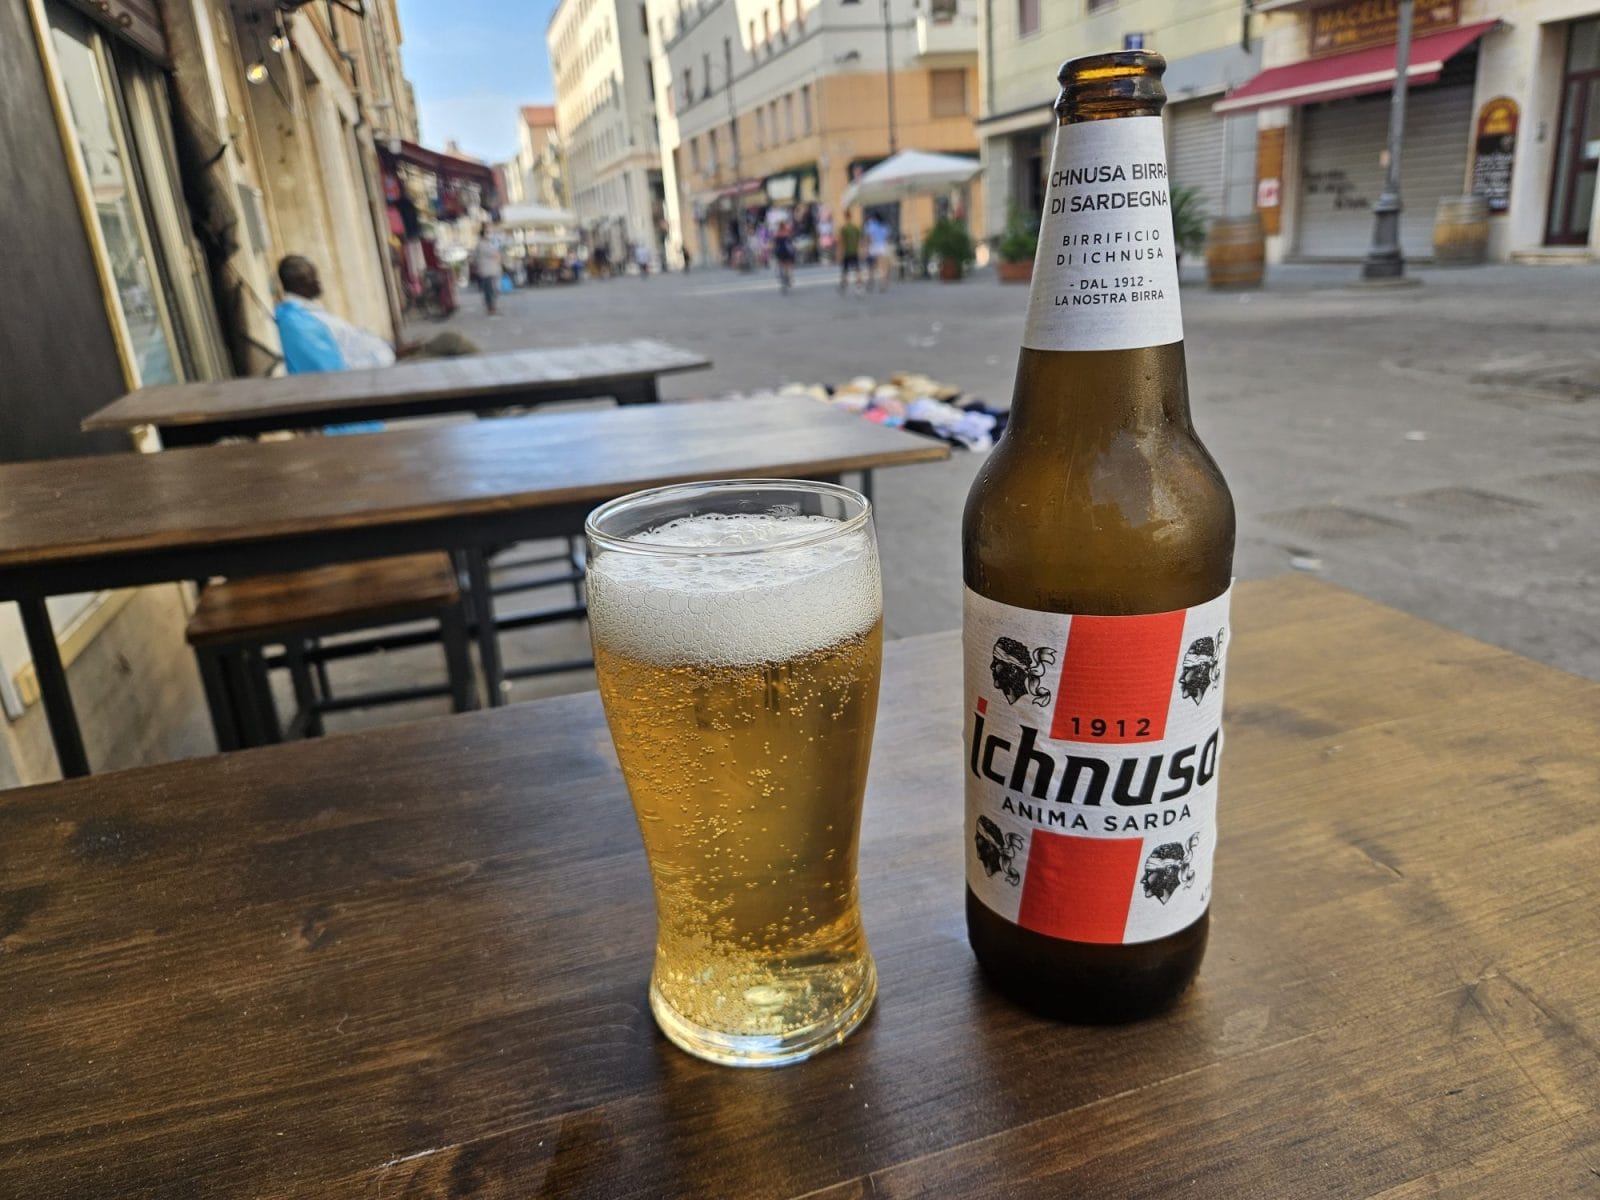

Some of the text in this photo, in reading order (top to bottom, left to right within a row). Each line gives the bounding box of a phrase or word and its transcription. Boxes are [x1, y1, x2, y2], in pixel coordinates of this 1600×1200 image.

[1051, 165, 1126, 187] CHNUSA
[1051, 191, 1168, 215] DI SARDEGNA
[1062, 230, 1160, 246] BIRRIFICIO
[1056, 248, 1163, 265] DI ICHNUSA
[1080, 279, 1108, 289] DAL
[1114, 276, 1144, 288] 1912
[1055, 289, 1164, 305] LA NOSTRA BIRRA
[1071, 717, 1150, 737] 1912
[1001, 796, 1191, 831] ANIMA SARDA
